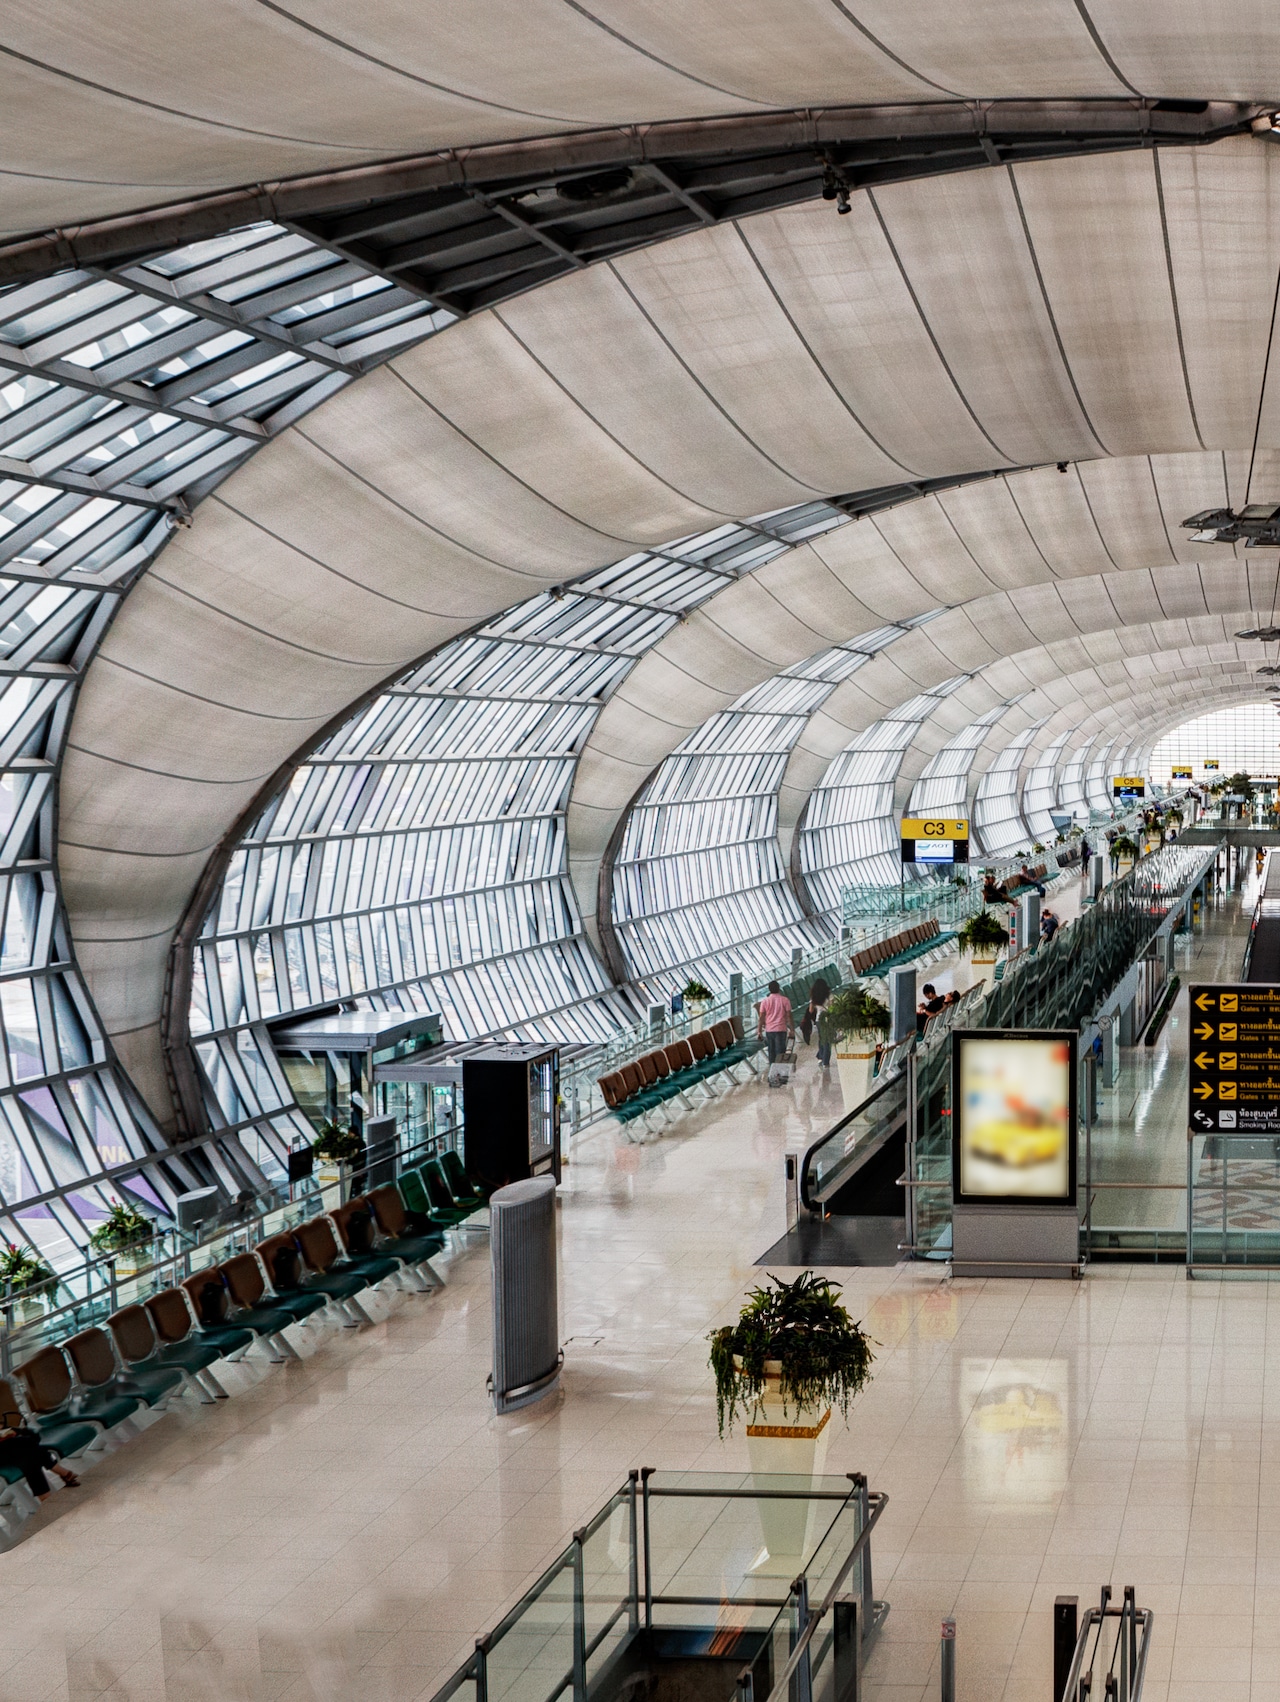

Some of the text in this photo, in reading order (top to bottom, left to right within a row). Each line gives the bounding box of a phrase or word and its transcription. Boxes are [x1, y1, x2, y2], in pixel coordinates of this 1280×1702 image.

[1123, 778, 1135, 786] C5
[923, 822, 945, 836] C3
[1239, 1121, 1267, 1130] Smoking
